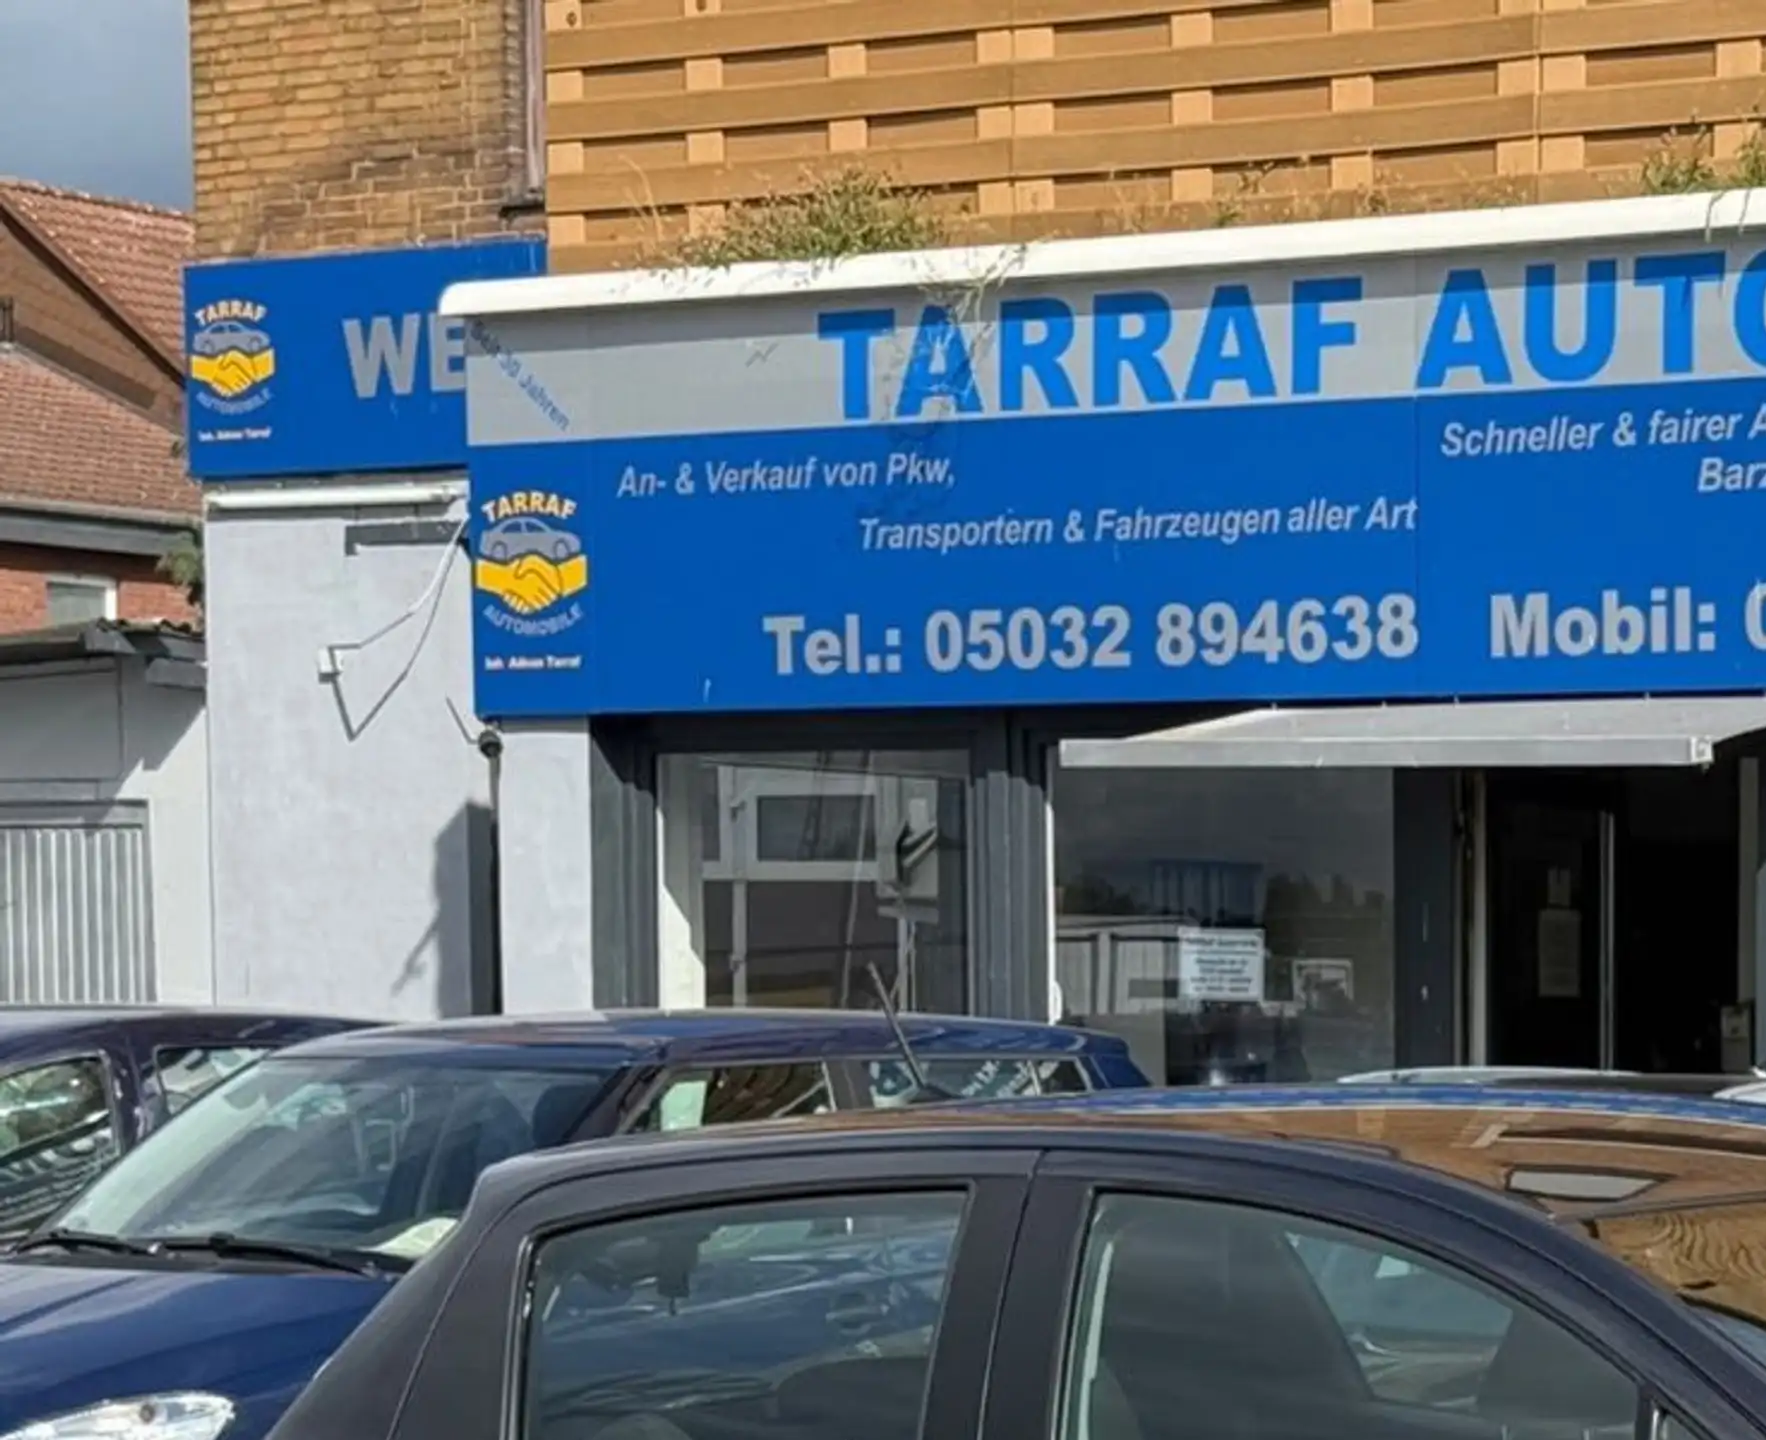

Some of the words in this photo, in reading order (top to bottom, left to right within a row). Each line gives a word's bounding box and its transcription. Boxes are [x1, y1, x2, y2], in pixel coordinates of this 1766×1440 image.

[194, 299, 267, 325] TARRAF
[817, 276, 1362, 420] TARRAF
[1441, 417, 1603, 456] Schneller
[1613, 412, 1636, 445] &
[1649, 408, 1742, 444] fairer
[617, 466, 666, 497] An-
[675, 460, 695, 494] &
[705, 456, 816, 492] Verkauf
[824, 462, 876, 489] von
[888, 452, 955, 489] Pkw,
[481, 491, 577, 523] TARRAF
[859, 512, 1052, 554] Transportern
[1064, 509, 1084, 542] &
[1095, 504, 1279, 544] Fahrzeugen
[1289, 499, 1359, 531] aller
[1366, 496, 1418, 529] Art
[483, 602, 583, 635] AUTOMOBILE
[764, 614, 901, 674] Tel.:
[925, 606, 1130, 672] 05032
[1156, 595, 1419, 668] 894638
[1491, 588, 1714, 658] Mobil:
